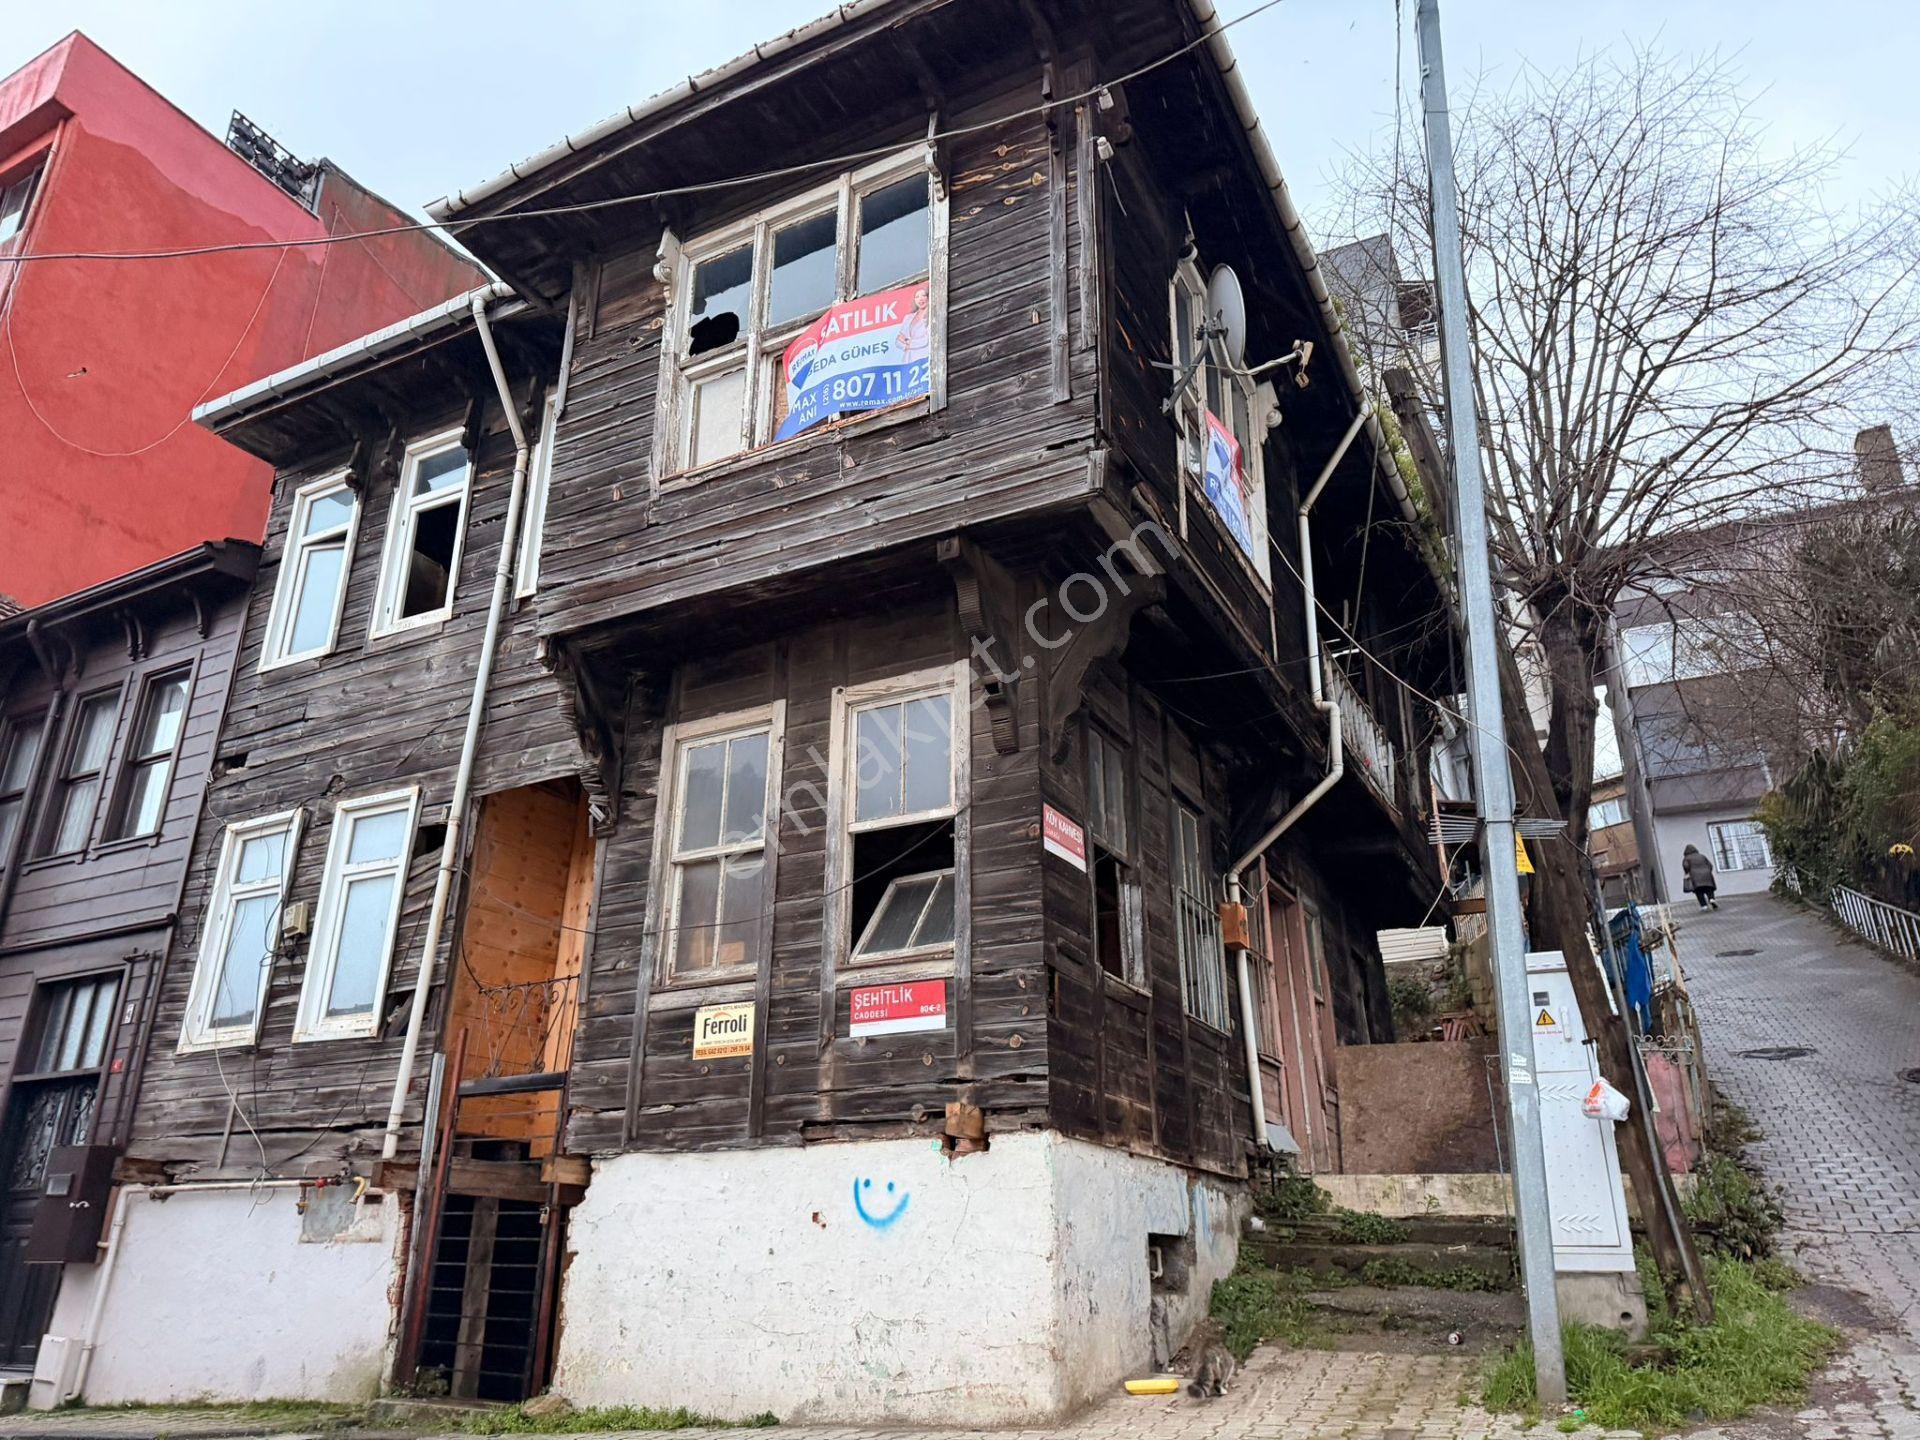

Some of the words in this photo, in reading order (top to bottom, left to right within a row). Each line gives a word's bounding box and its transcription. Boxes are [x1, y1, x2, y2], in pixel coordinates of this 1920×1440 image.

[840, 340, 890, 363] GÜNEŞ
[832, 372, 876, 400] 807
[882, 370, 902, 394] 11
[908, 362, 931, 388] 22
[854, 986, 913, 1010] ŞEHİTLİK
[703, 1014, 747, 1039] Ferroli
[854, 1009, 888, 1020] CADDESİ
